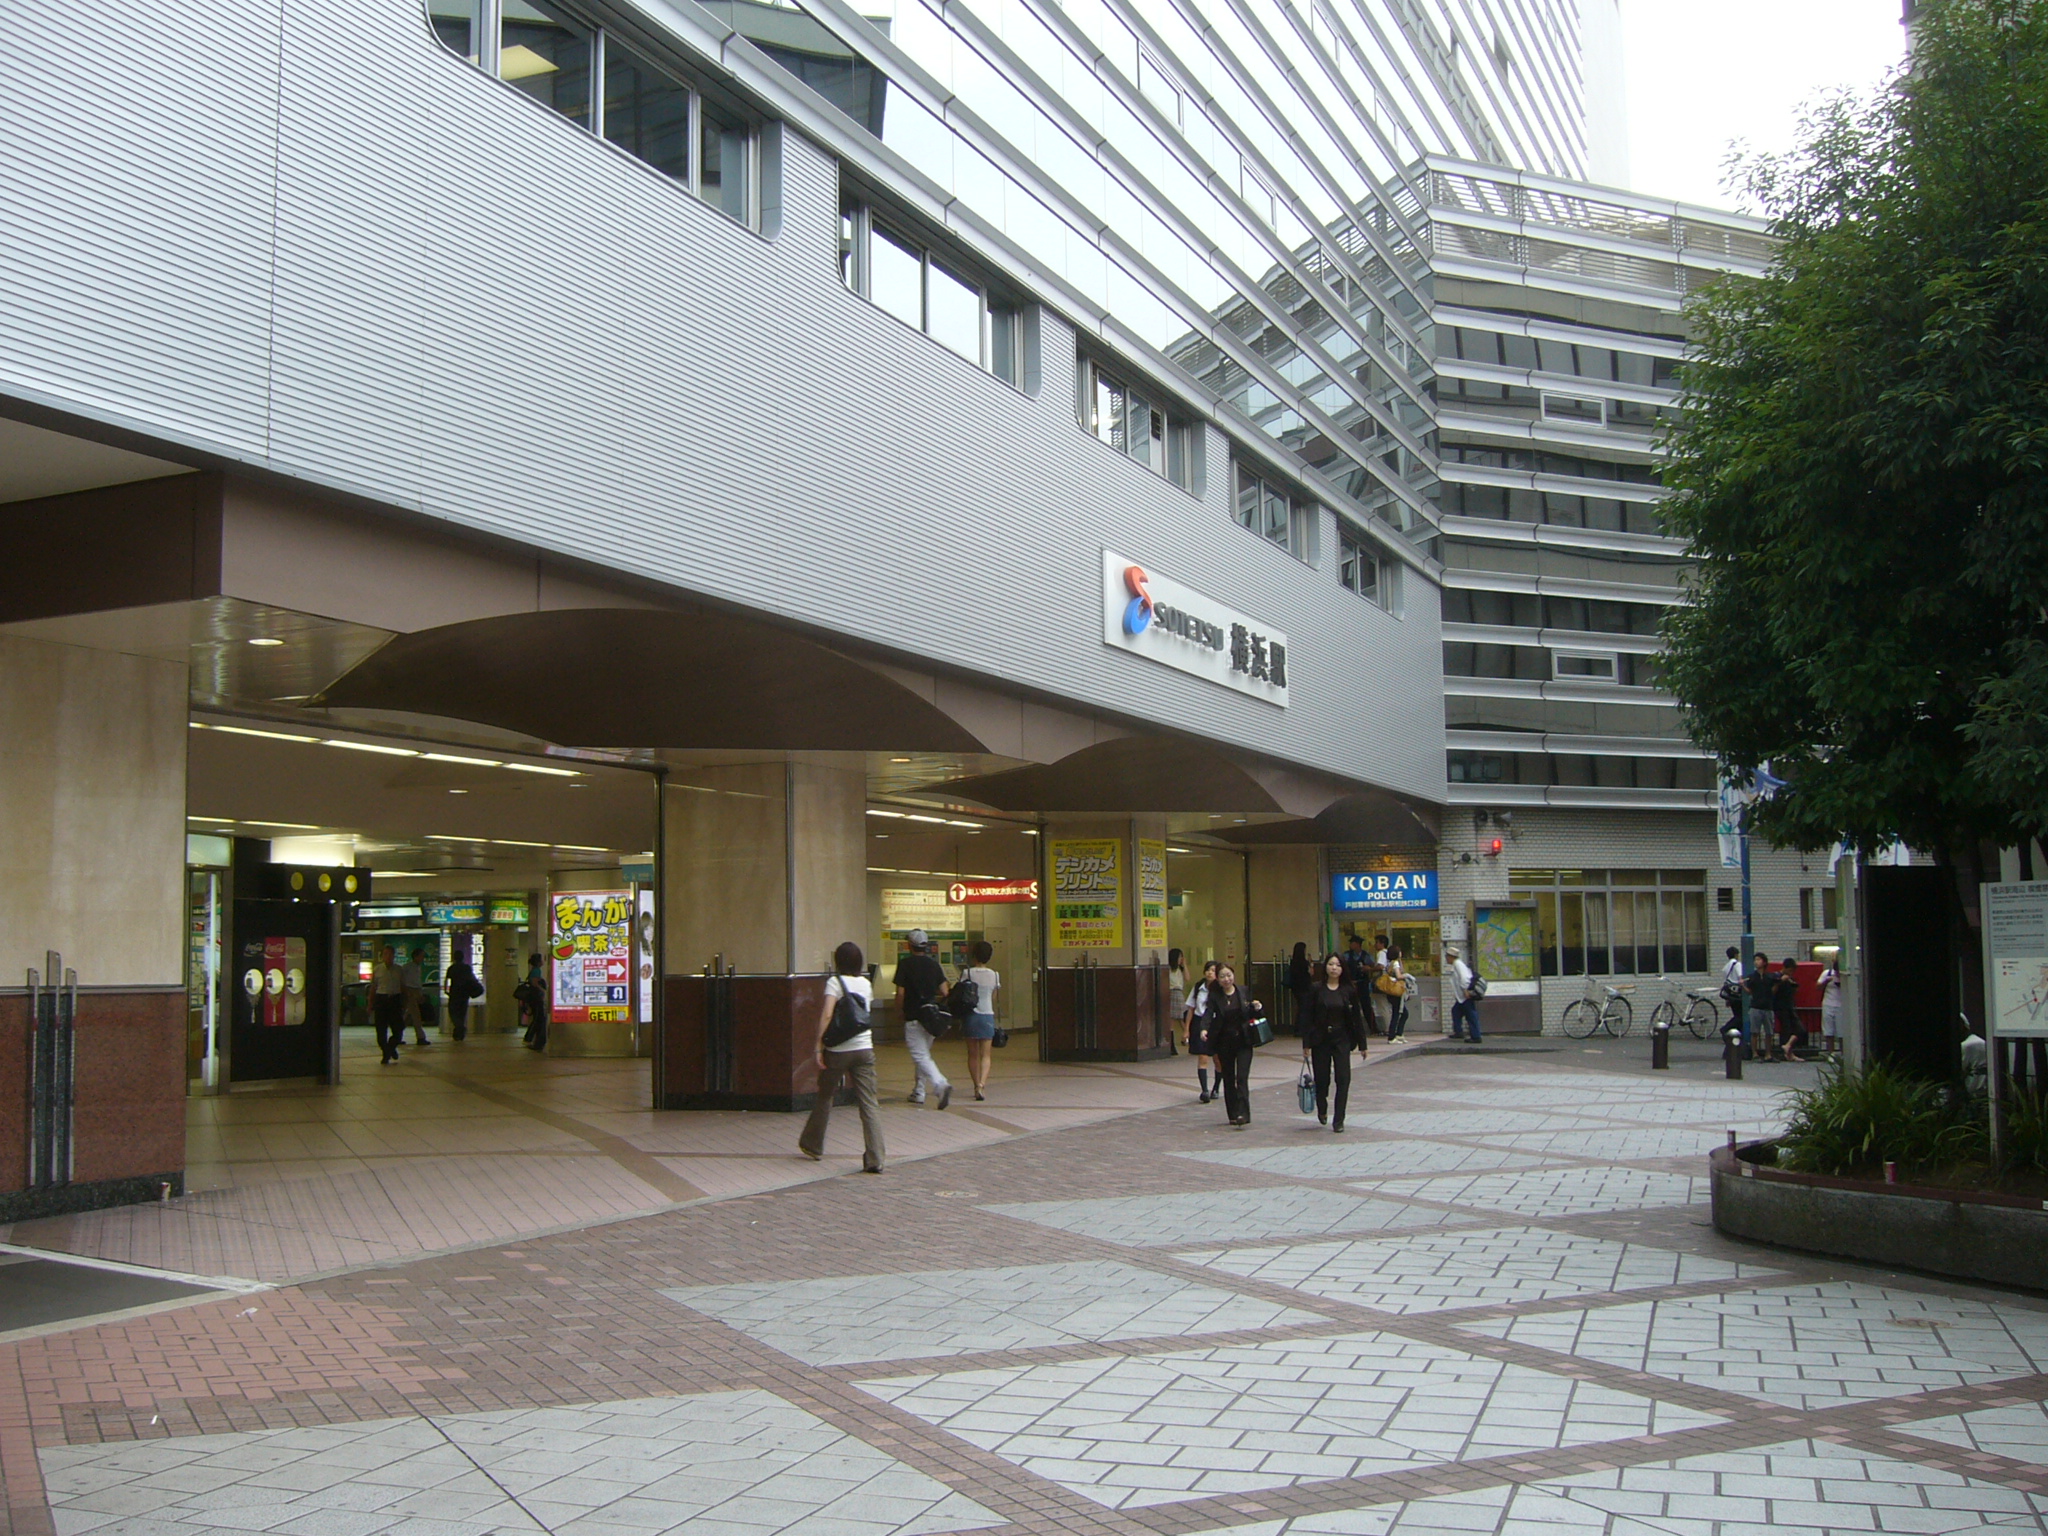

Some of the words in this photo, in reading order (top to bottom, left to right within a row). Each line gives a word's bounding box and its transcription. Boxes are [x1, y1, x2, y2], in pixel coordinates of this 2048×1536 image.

[1154, 602, 1224, 651] SOTETSU
[1230, 622, 1287, 689] 横浜駅
[1055, 855, 1116, 874] デジカメ
[1055, 873, 1103, 890] プリント
[1344, 874, 1427, 891] KOBAN
[1367, 891, 1404, 900] POLICE
[555, 895, 629, 931] まんが
